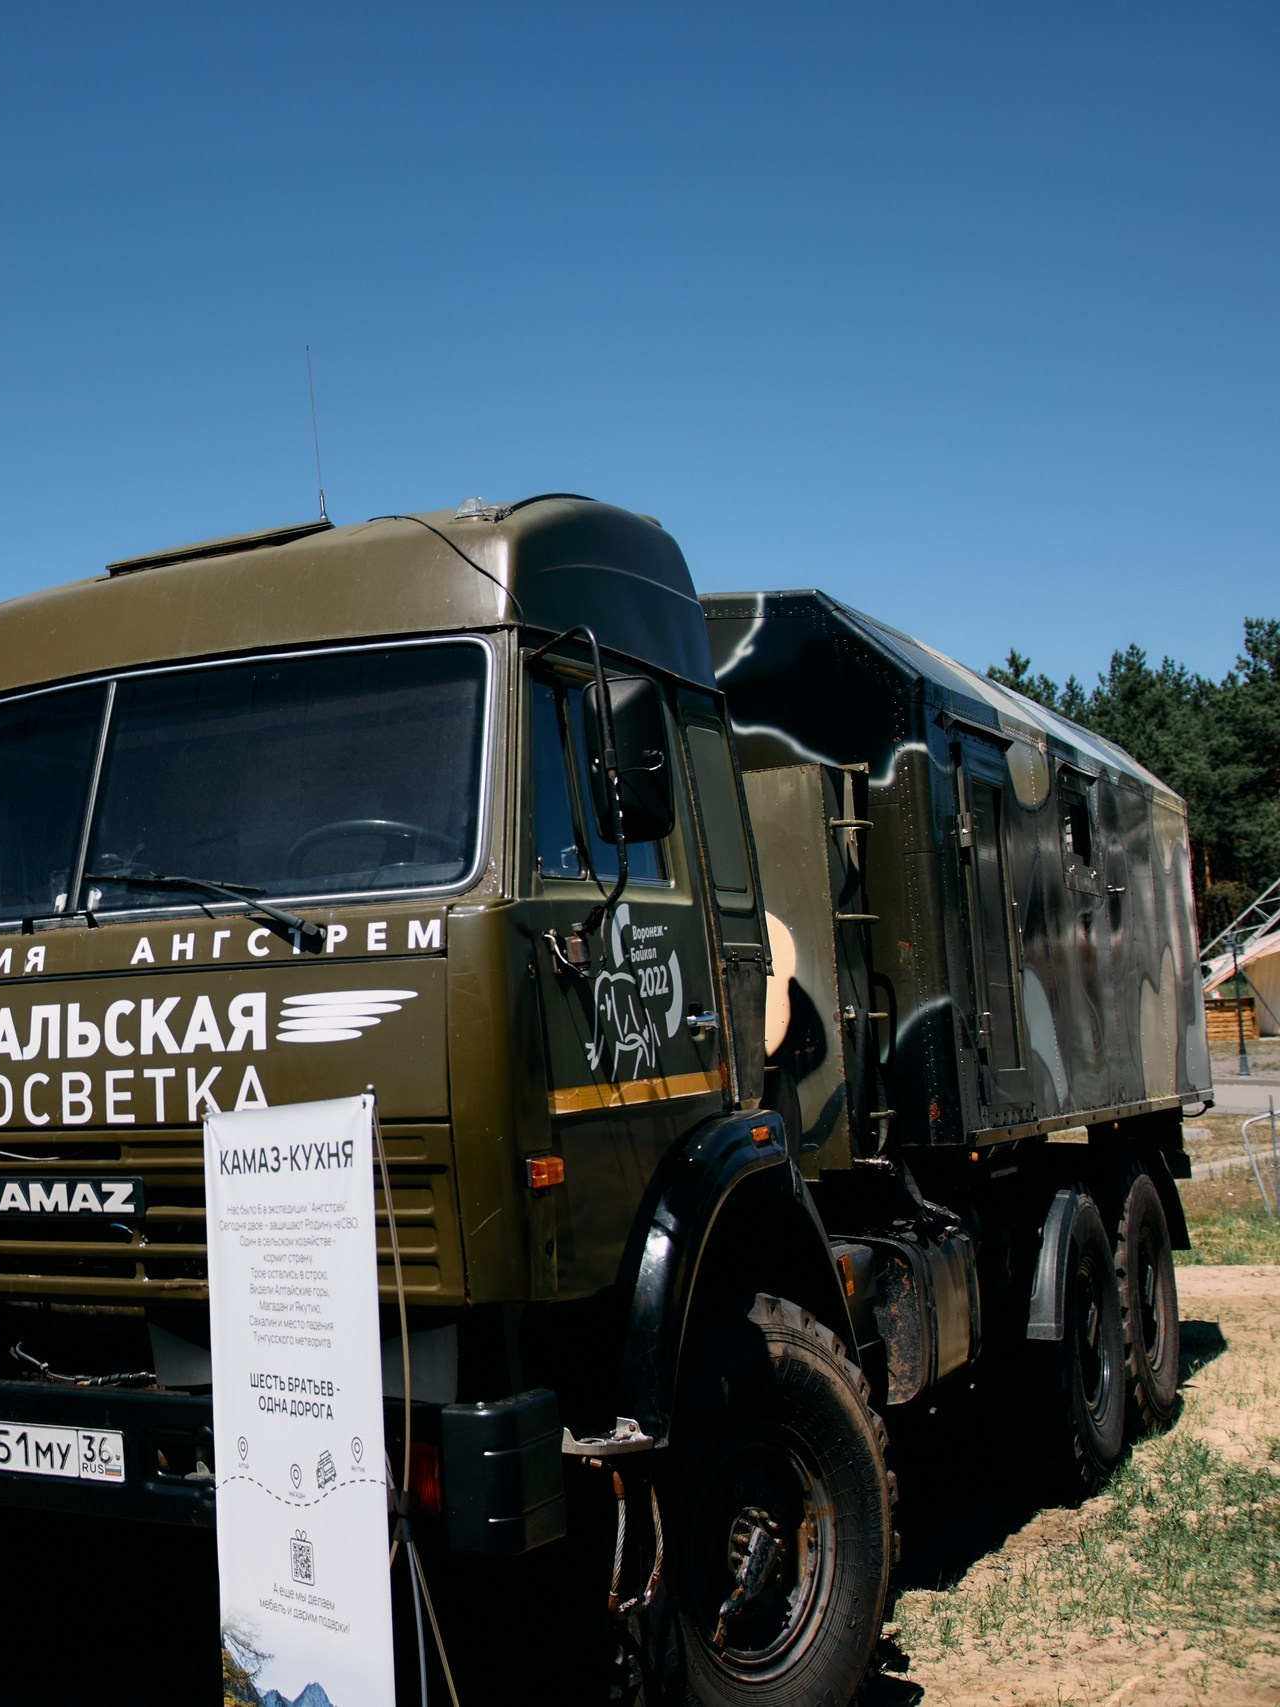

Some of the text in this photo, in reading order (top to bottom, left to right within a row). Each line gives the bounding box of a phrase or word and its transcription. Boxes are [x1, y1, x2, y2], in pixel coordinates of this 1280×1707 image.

[130, 919, 441, 965] АНГСТРЕМ
[637, 965, 669, 998] 2022
[220, 1140, 353, 1175] КАМАЗ-КУХНЯ
[227, 1205, 239, 1215] Нас
[240, 1204, 257, 1215] было
[268, 1205, 308, 1215] экспедиции
[219, 1219, 246, 1231] Сегодня
[247, 1221, 263, 1231] двое
[269, 1221, 304, 1231] защищают
[305, 1218, 332, 1232] Родину
[333, 1221, 341, 1229] на
[239, 1235, 257, 1247] Один
[262, 1237, 294, 1247] сельском
[295, 1235, 332, 1247] хозяйстве
[263, 1254, 287, 1265] кормит
[251, 1267, 267, 1281] Трое
[267, 1270, 299, 1280] остались
[250, 1284, 274, 1295] Видели
[275, 1284, 312, 1297] Алтайские
[259, 1300, 288, 1312] Магадан
[248, 1315, 277, 1328] Сахалин
[283, 1319, 305, 1329] место
[306, 1321, 334, 1332] падения
[253, 1331, 331, 1349] Тунгусского метеорита
[250, 1372, 286, 1391] ШЕСТЬ
[288, 1376, 334, 1397] БРАТЬЕВ
[258, 1395, 334, 1420] ОДНА ДОРОГА
[82, 1435, 112, 1465] 36
[82, 1462, 104, 1475] RUS
[273, 1583, 335, 1611] А еще мы делаем
[259, 1598, 351, 1635] мебель и дарим подарки!
